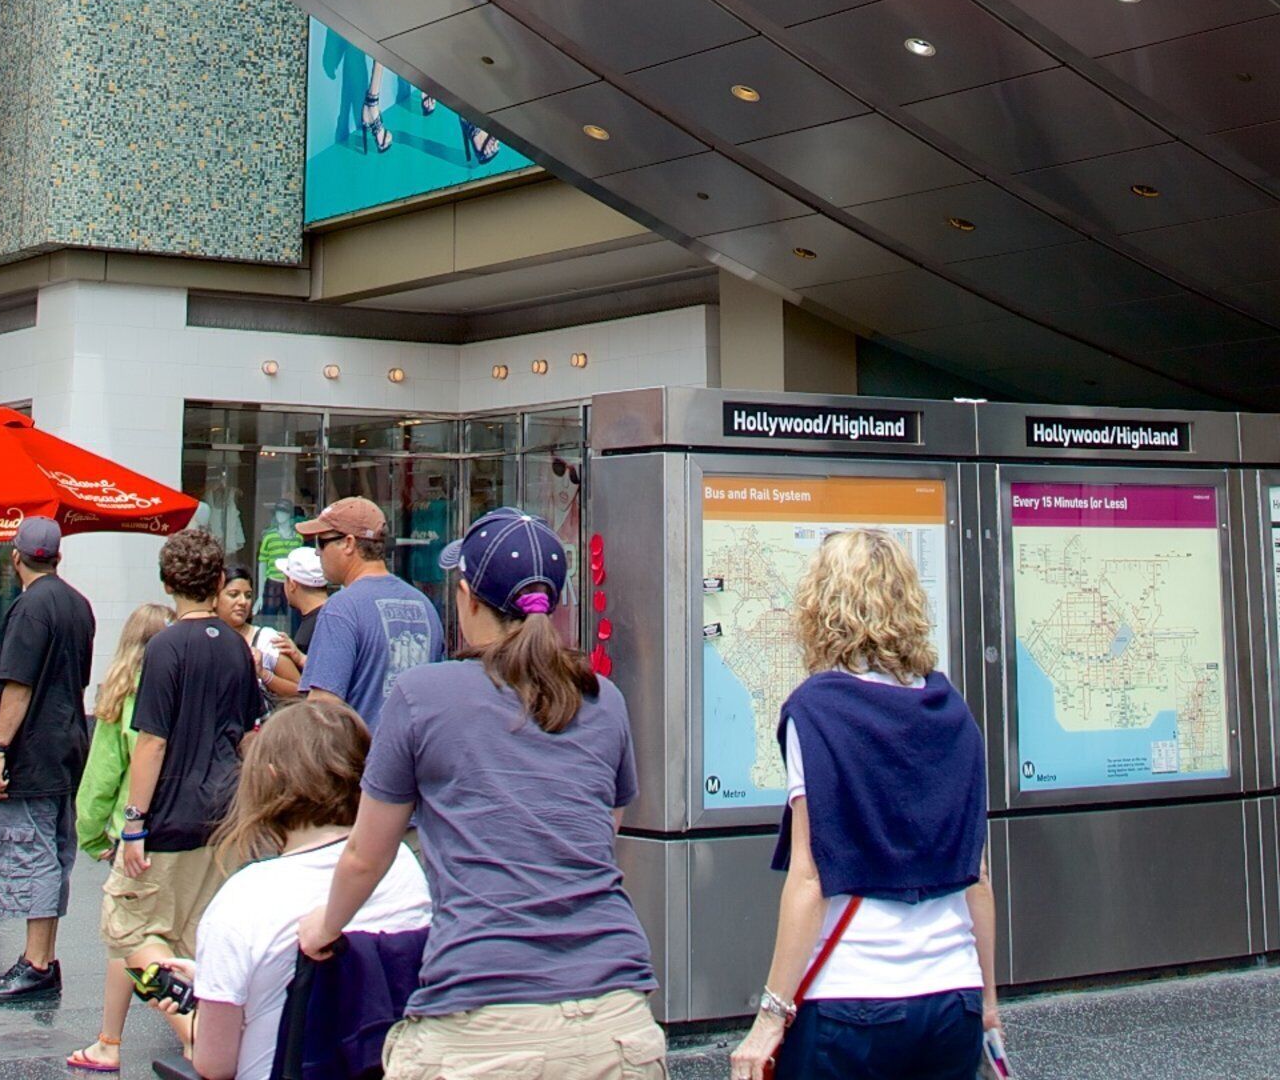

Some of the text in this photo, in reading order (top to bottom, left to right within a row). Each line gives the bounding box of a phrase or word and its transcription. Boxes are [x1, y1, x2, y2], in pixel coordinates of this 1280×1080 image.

[733, 410, 905, 440] Hollywood/Highland
[1033, 423, 1179, 449] Hollywood/Highland
[704, 487, 812, 504] Bus and Rail System
[1012, 495, 1128, 510] Every 15 Minutes (or Less)
[1036, 774, 1057, 782] Metro
[722, 789, 746, 799] Metro
